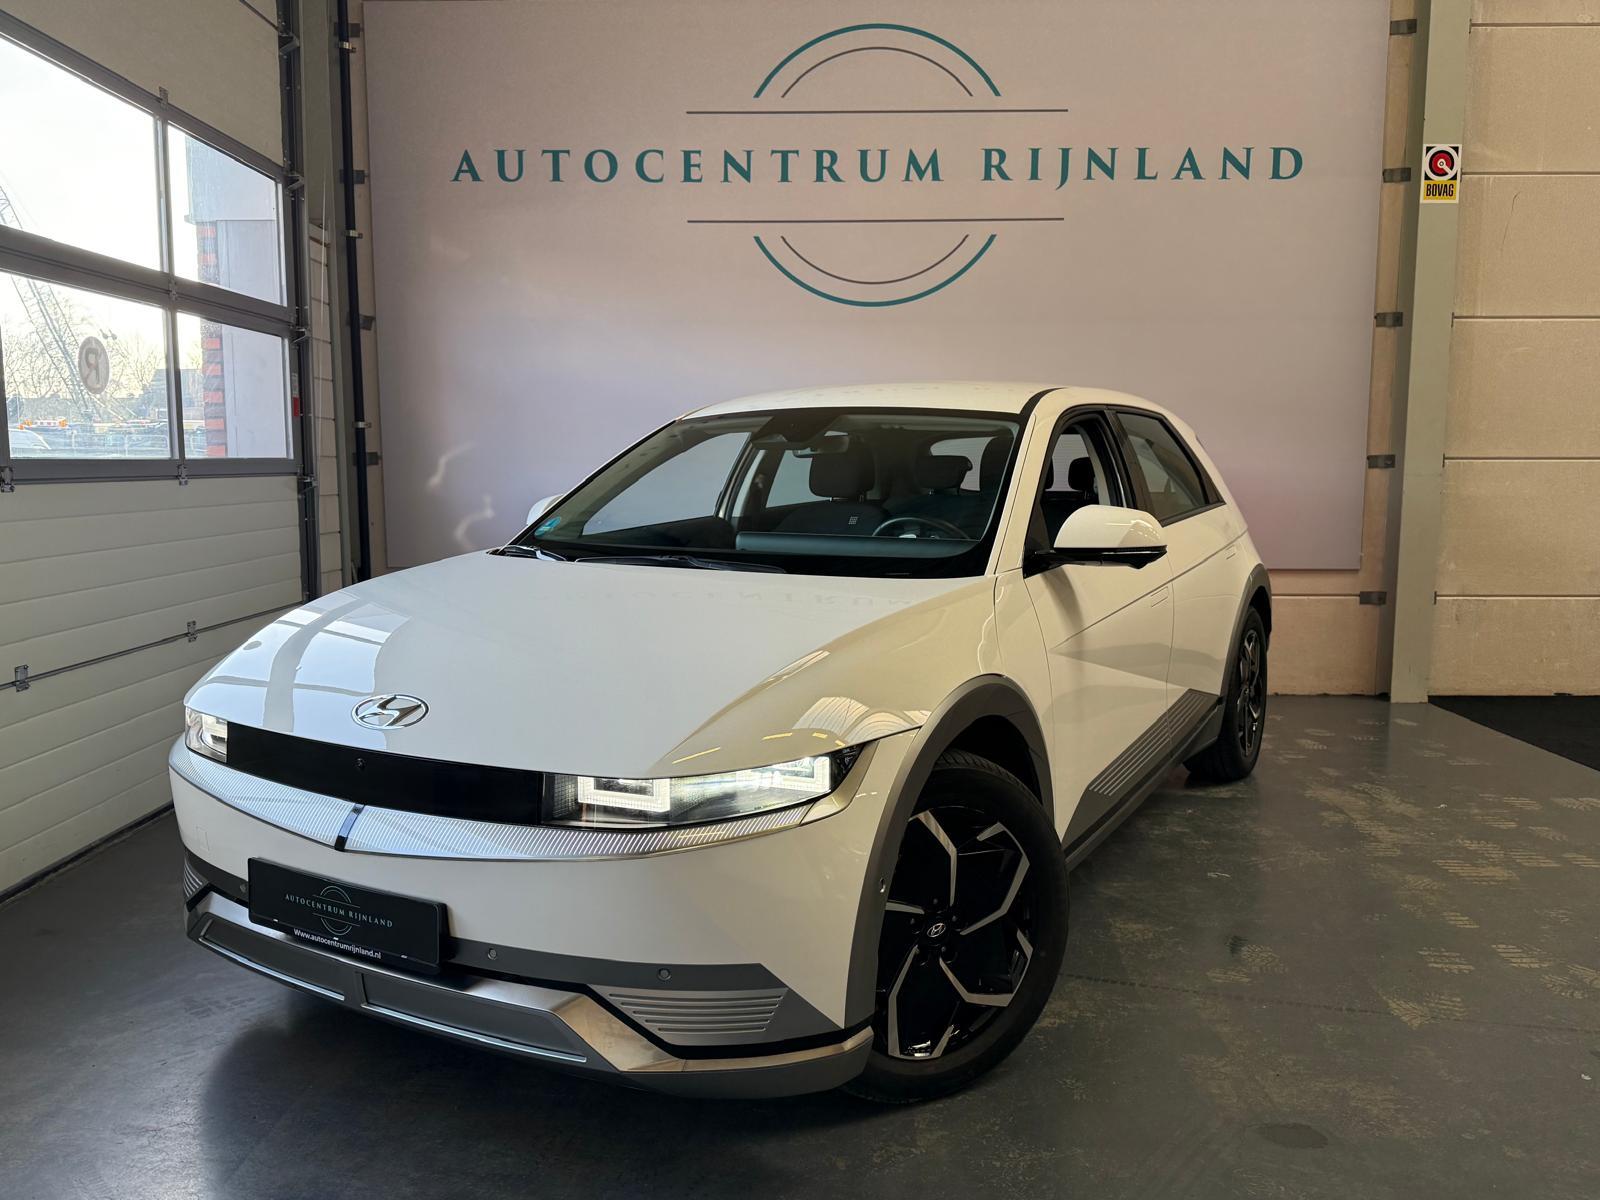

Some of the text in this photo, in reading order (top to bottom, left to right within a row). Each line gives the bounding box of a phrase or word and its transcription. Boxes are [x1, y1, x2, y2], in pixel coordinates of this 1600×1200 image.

[450, 146, 1304, 190] AUTOCENTRUM RIJNLAND
[1425, 183, 1454, 197] BOVAG
[285, 894, 393, 928] AUTOCENTRUM RIJNLAND
